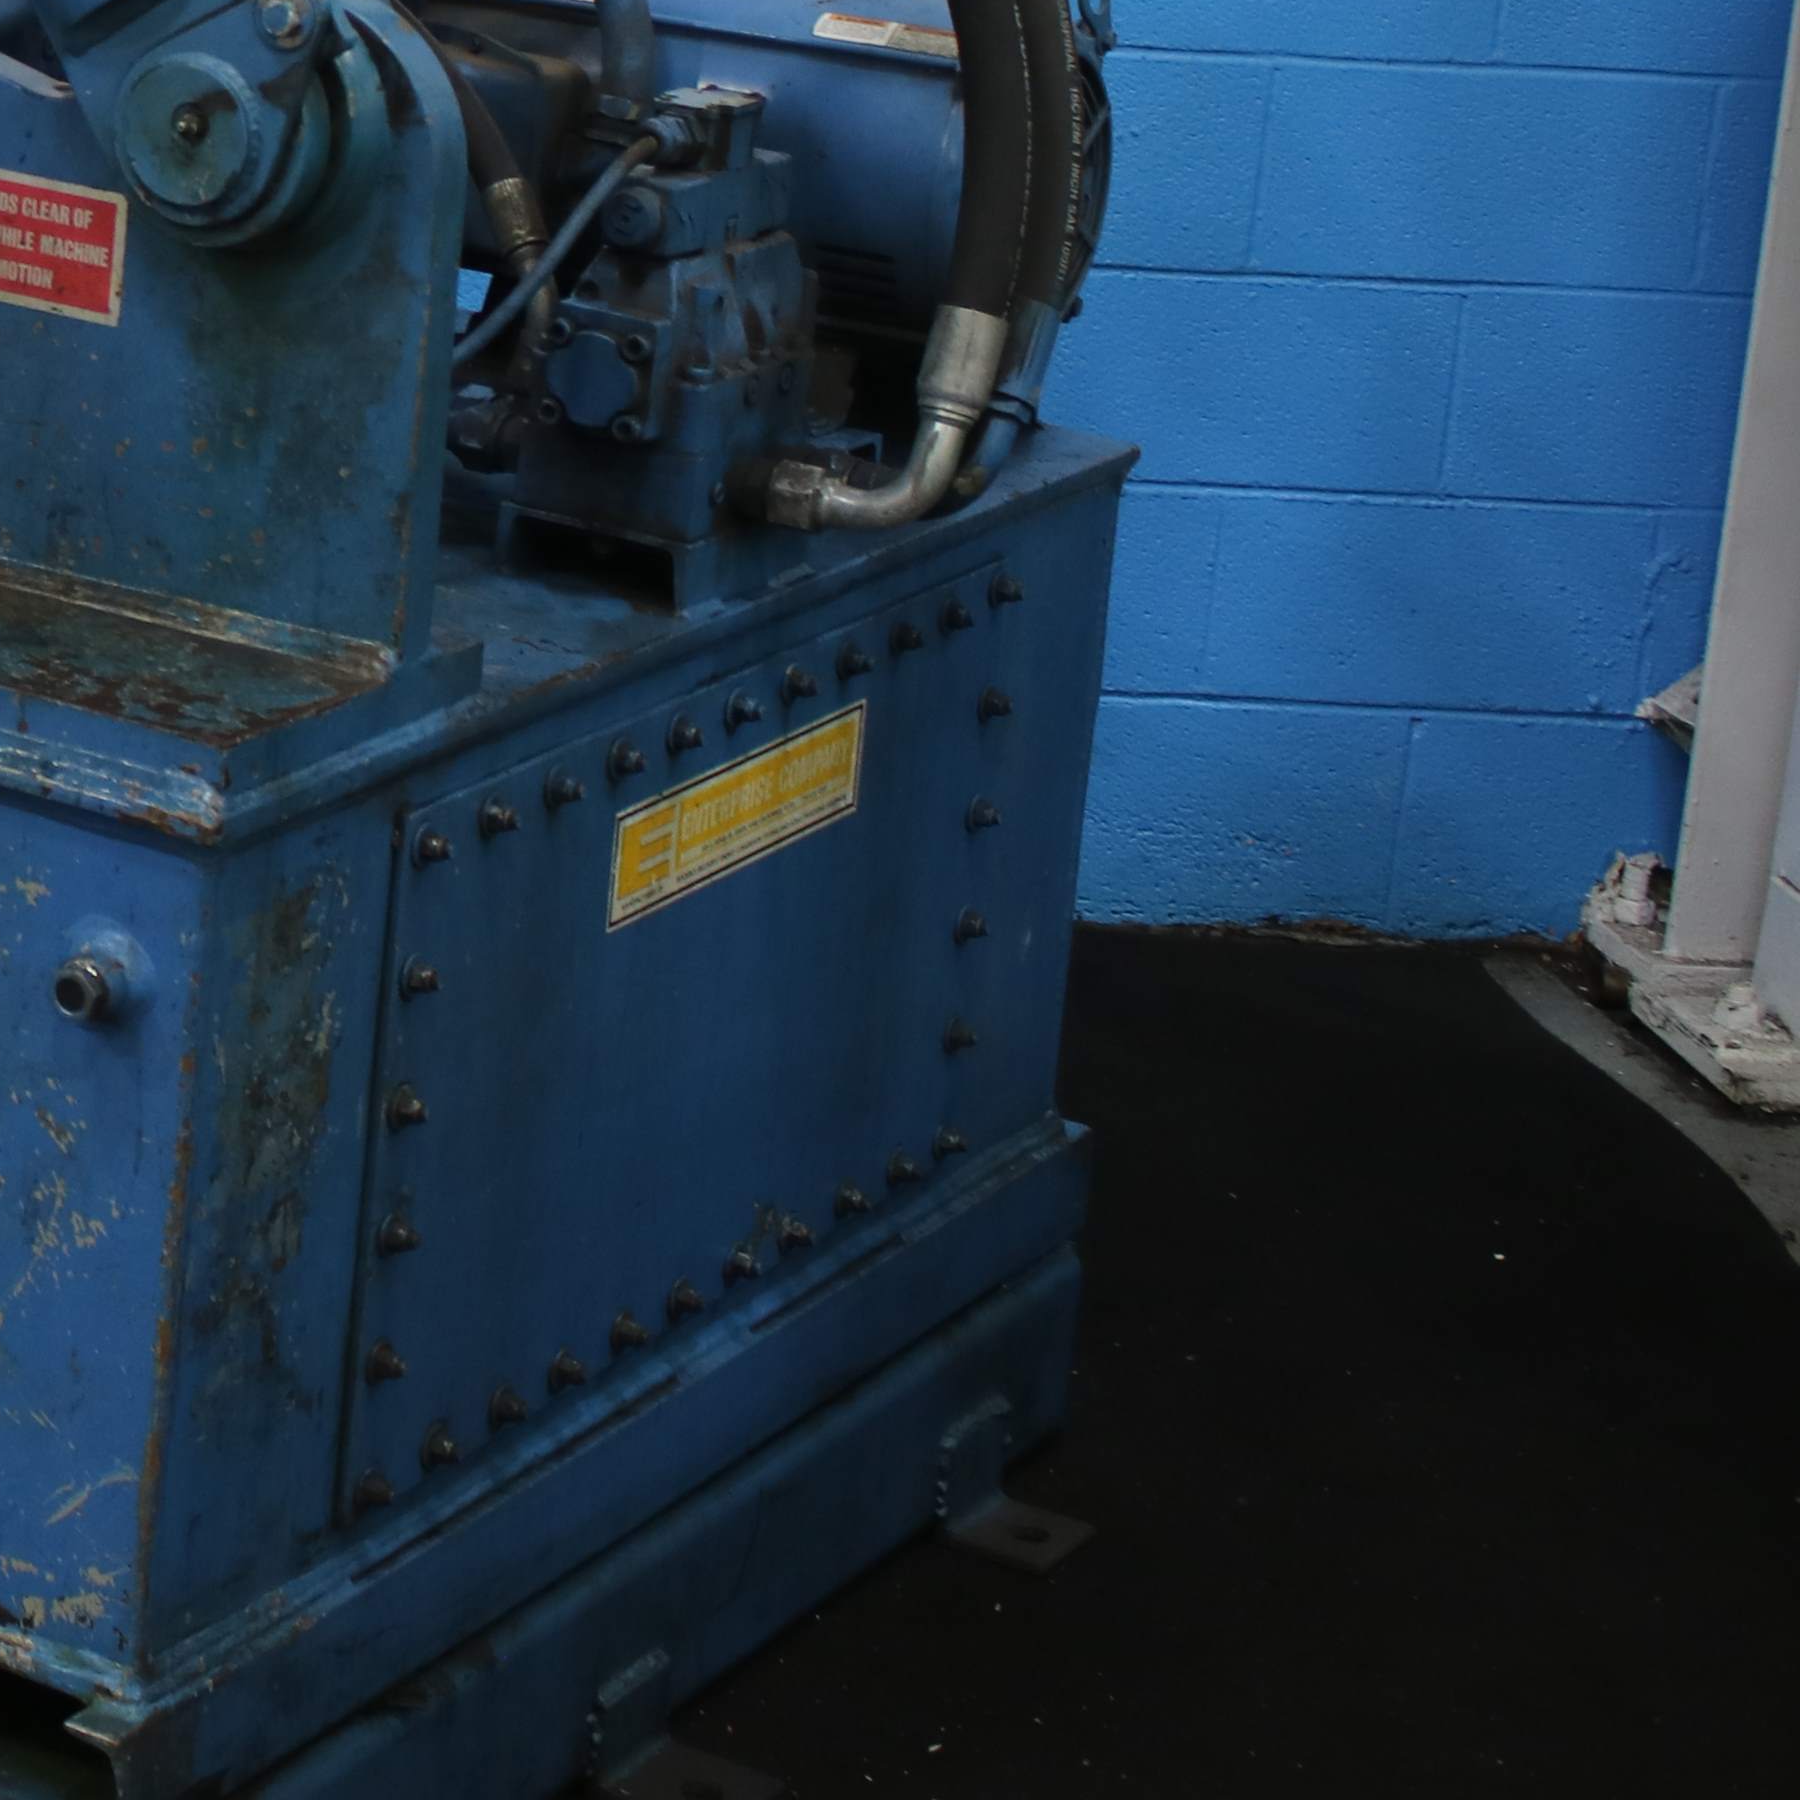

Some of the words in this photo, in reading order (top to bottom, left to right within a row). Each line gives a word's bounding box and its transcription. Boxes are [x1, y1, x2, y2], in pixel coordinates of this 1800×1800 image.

[21, 197, 72, 225] CLEAR
[73, 210, 94, 229] OF
[40, 233, 111, 268] MACHINE
